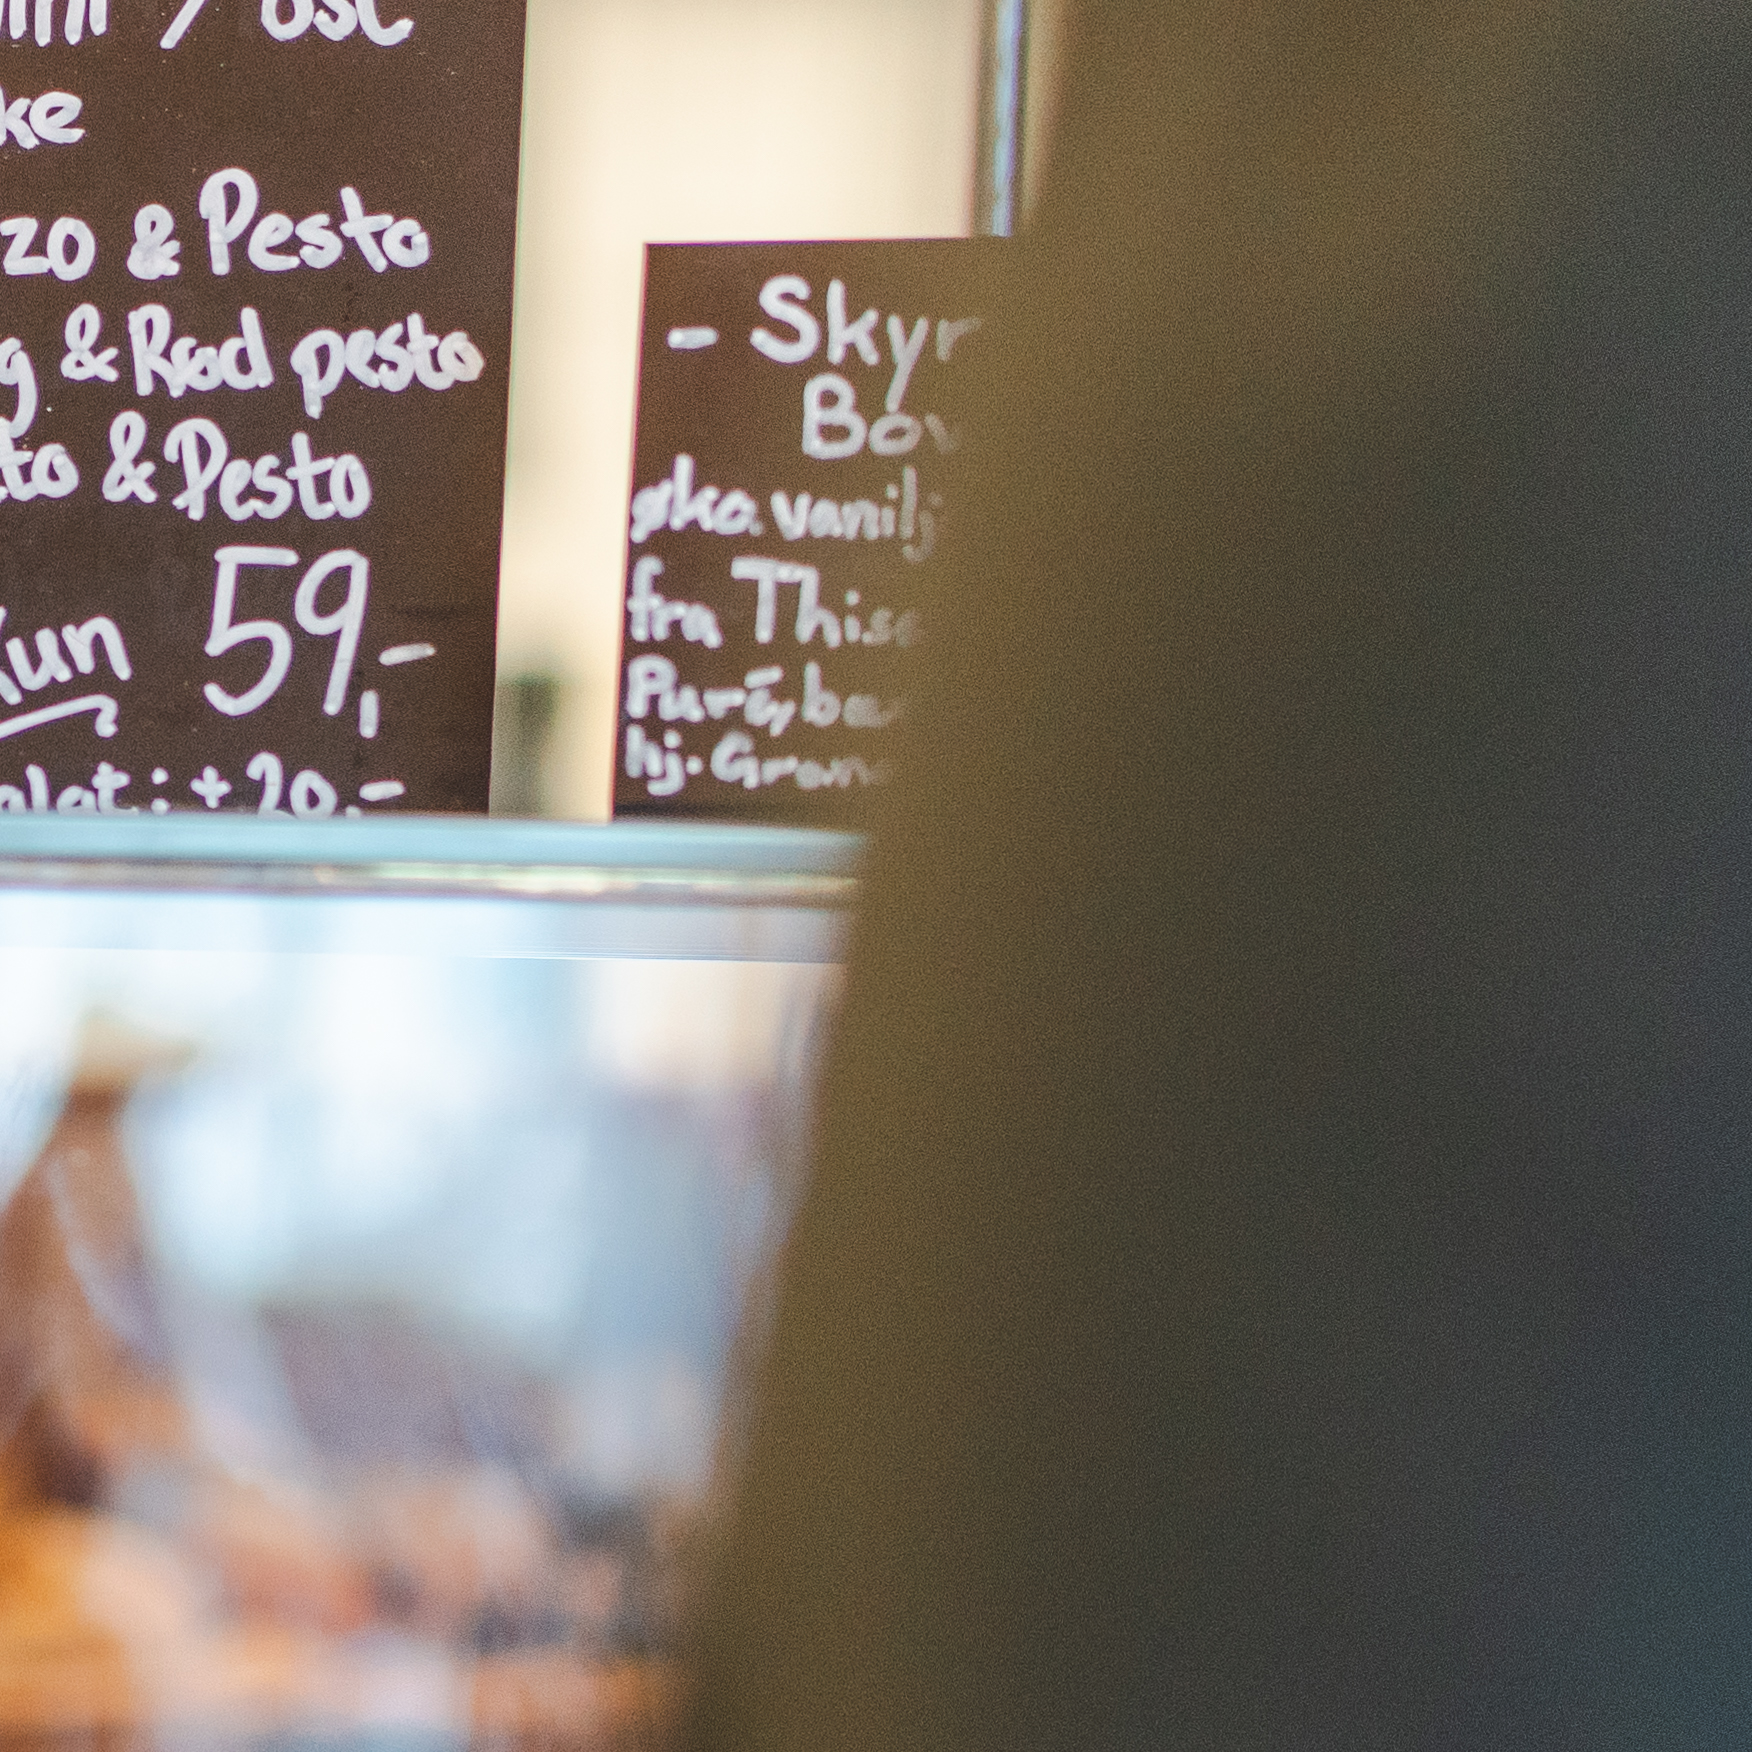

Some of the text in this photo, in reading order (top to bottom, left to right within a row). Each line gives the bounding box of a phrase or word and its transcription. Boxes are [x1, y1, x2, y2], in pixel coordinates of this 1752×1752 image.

[125, 202, 181, 281] &
[198, 166, 431, 276] Pesto
[59, 302, 120, 383] &
[748, 273, 986, 416] Skyr
[101, 409, 158, 504] &
[162, 416, 372, 522] Pesto
[203, 544, 436, 739] 59,-
[624, 552, 724, 650] fra
